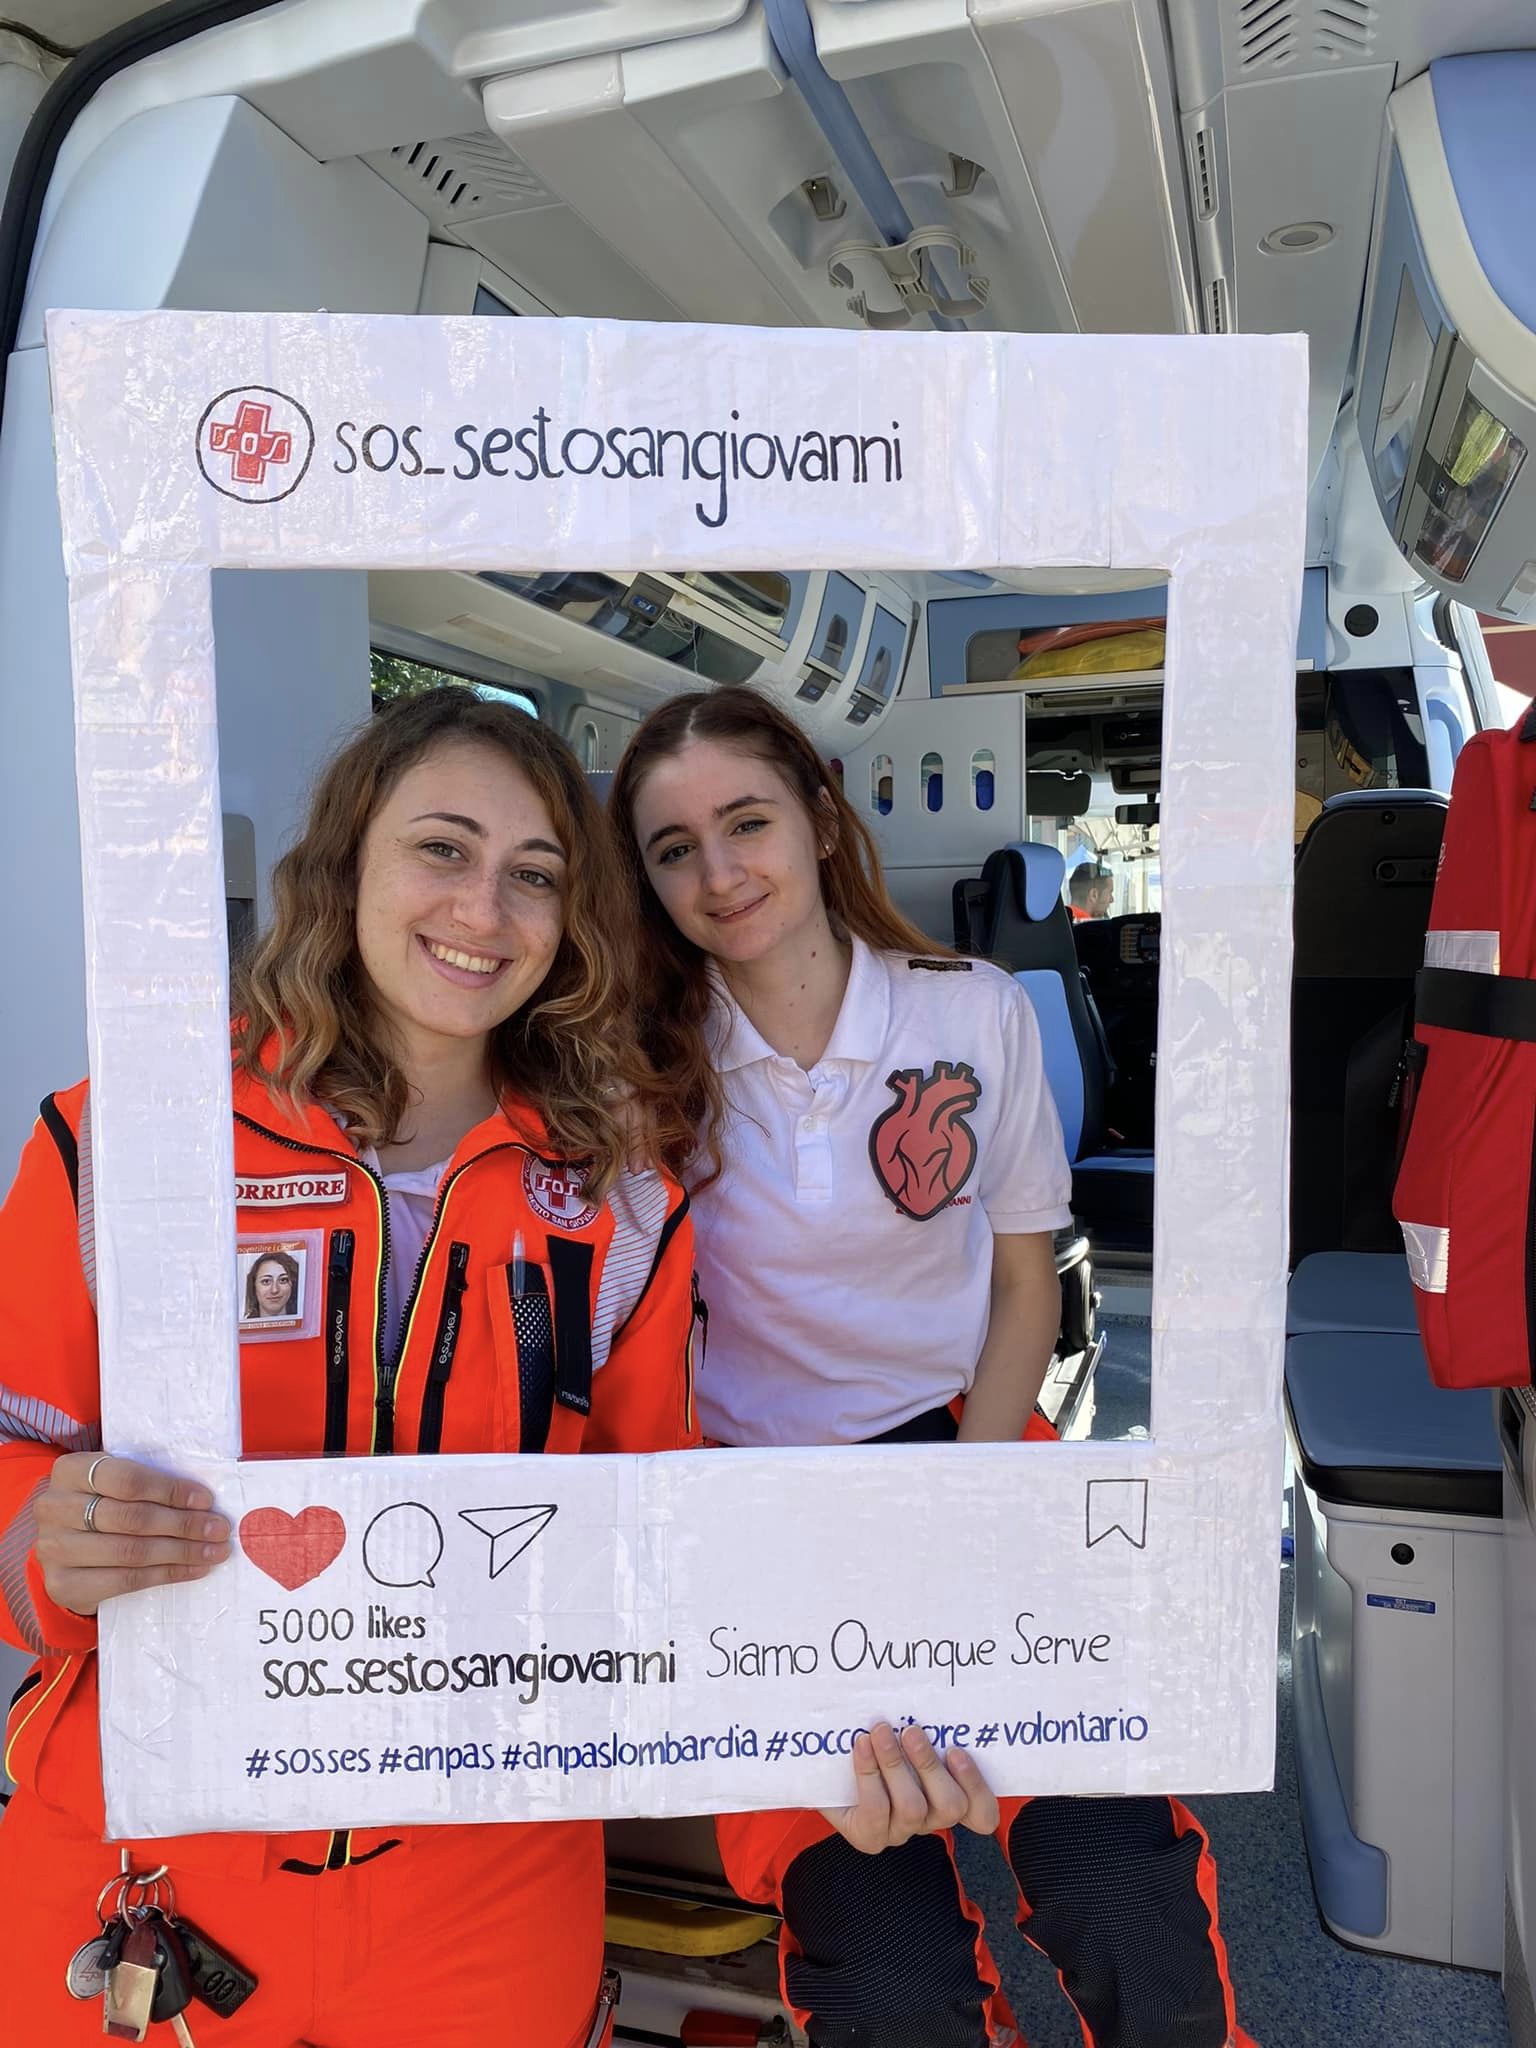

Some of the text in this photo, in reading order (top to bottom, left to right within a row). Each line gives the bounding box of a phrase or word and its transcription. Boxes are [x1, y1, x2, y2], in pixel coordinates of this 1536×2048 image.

[212, 428, 289, 460] SOS
[334, 407, 903, 528] sos_sestosangiovanni
[536, 1177, 579, 1196] SOS
[439, 1311, 456, 1364] reverse
[258, 1605, 427, 1644] 5000 likes
[263, 1613, 1112, 1705] sos_sestosangiovanni Siamo Ovunque Serve
[246, 1748, 371, 1778] #sosses
[379, 1743, 494, 1778] #anpas
[502, 1724, 759, 1775] #anpaslombardia
[975, 1708, 1149, 1748] #volontario
